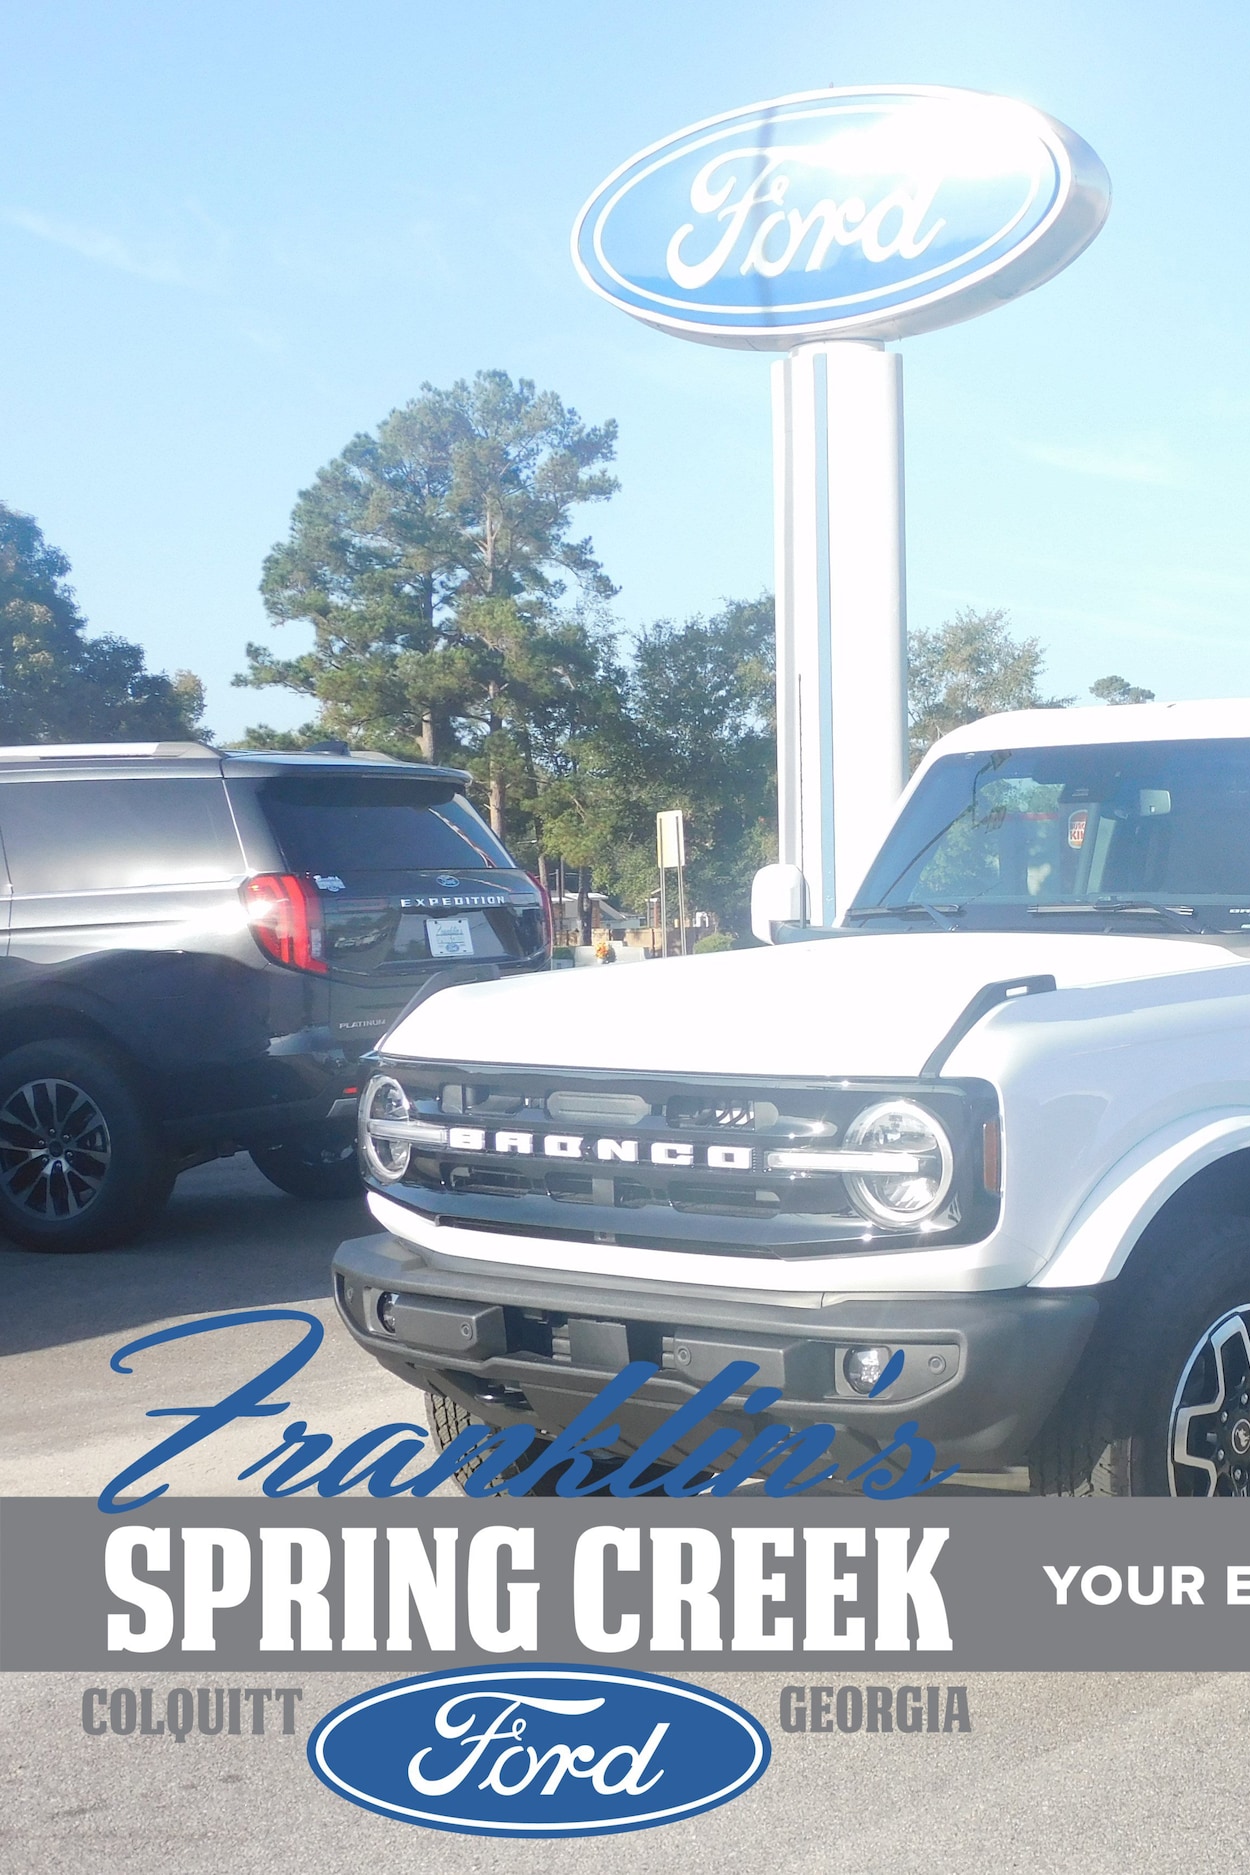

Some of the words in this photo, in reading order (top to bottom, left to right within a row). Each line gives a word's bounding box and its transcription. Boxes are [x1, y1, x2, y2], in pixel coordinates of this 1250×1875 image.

[666, 145, 947, 290] Ford
[401, 895, 505, 908] EXPEDITION
[339, 1019, 386, 1029] PLATINUM
[449, 1126, 753, 1170] BRONCO
